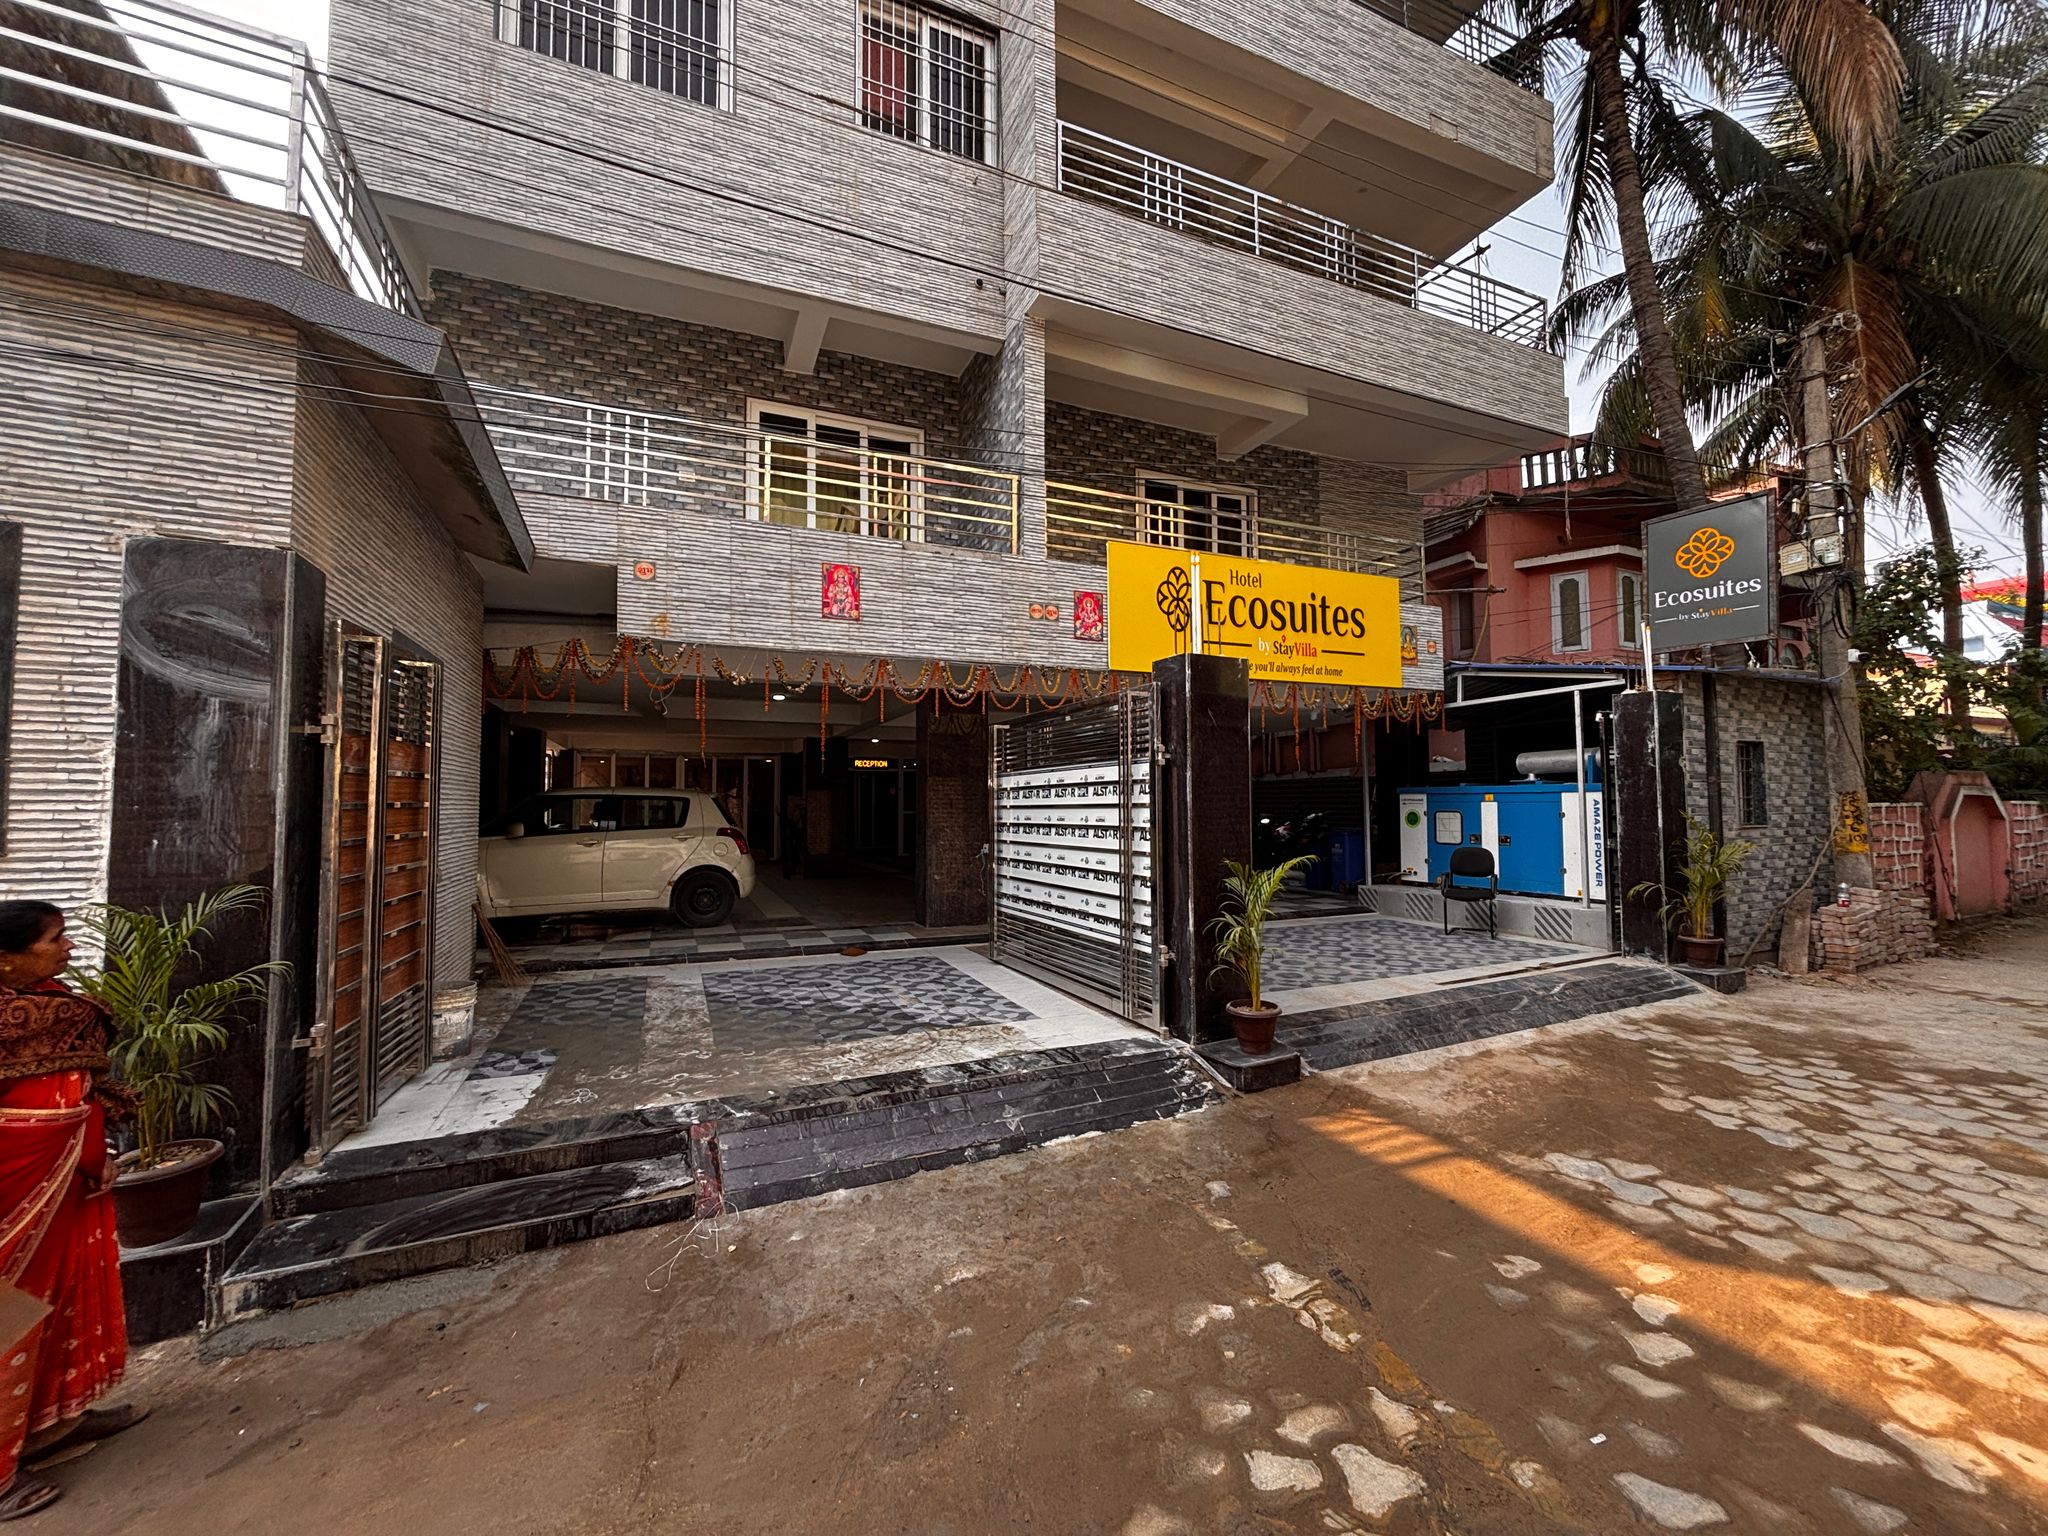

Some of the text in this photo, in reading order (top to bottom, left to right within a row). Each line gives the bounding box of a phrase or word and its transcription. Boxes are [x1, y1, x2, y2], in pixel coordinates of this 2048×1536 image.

[1230, 569, 1262, 588] Hotel
[1654, 578, 1762, 608] Ecosuites
[1203, 579, 1366, 638] Ecosuites
[1678, 608, 1732, 622] by StayVilla
[1258, 636, 1318, 659] by StayVilla
[1254, 662, 1274, 674] you'll
[1276, 663, 1300, 676] always
[1301, 664, 1315, 677] feel
[1315, 666, 1323, 676] at
[1324, 666, 1343, 677] home
[1054, 787, 1076, 798] ALSTAR
[1092, 785, 1118, 797] ALSTAR
[1054, 827, 1076, 838] ALSTAR
[1093, 828, 1119, 840] ALSTAR
[1593, 799, 1603, 887] AMAZE POWER
